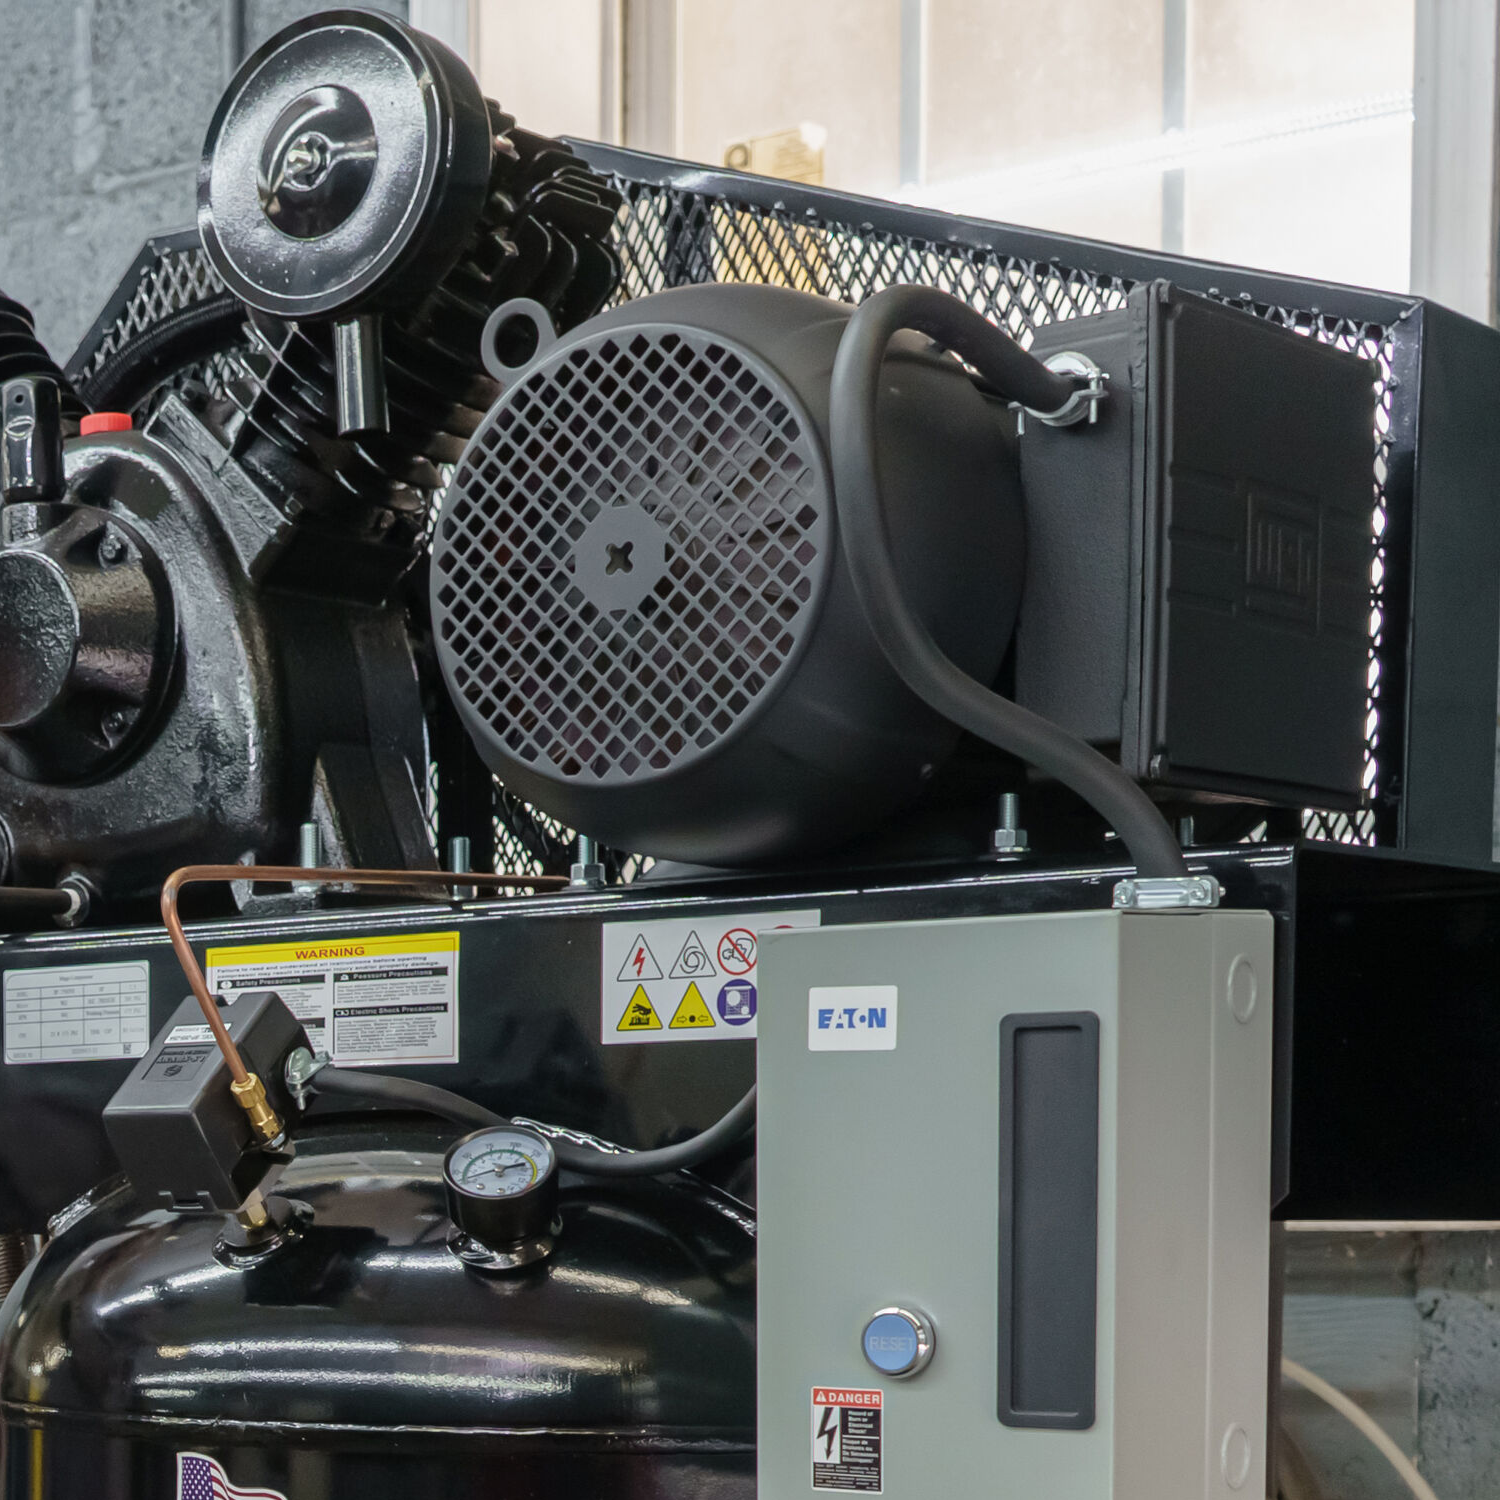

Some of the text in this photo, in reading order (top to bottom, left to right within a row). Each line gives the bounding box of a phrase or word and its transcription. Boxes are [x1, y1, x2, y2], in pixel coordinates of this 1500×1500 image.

[295, 946, 365, 960] WARNING
[818, 1008, 887, 1029] EATON
[869, 1336, 914, 1351] RESET
[828, 1392, 880, 1404] DANGER
